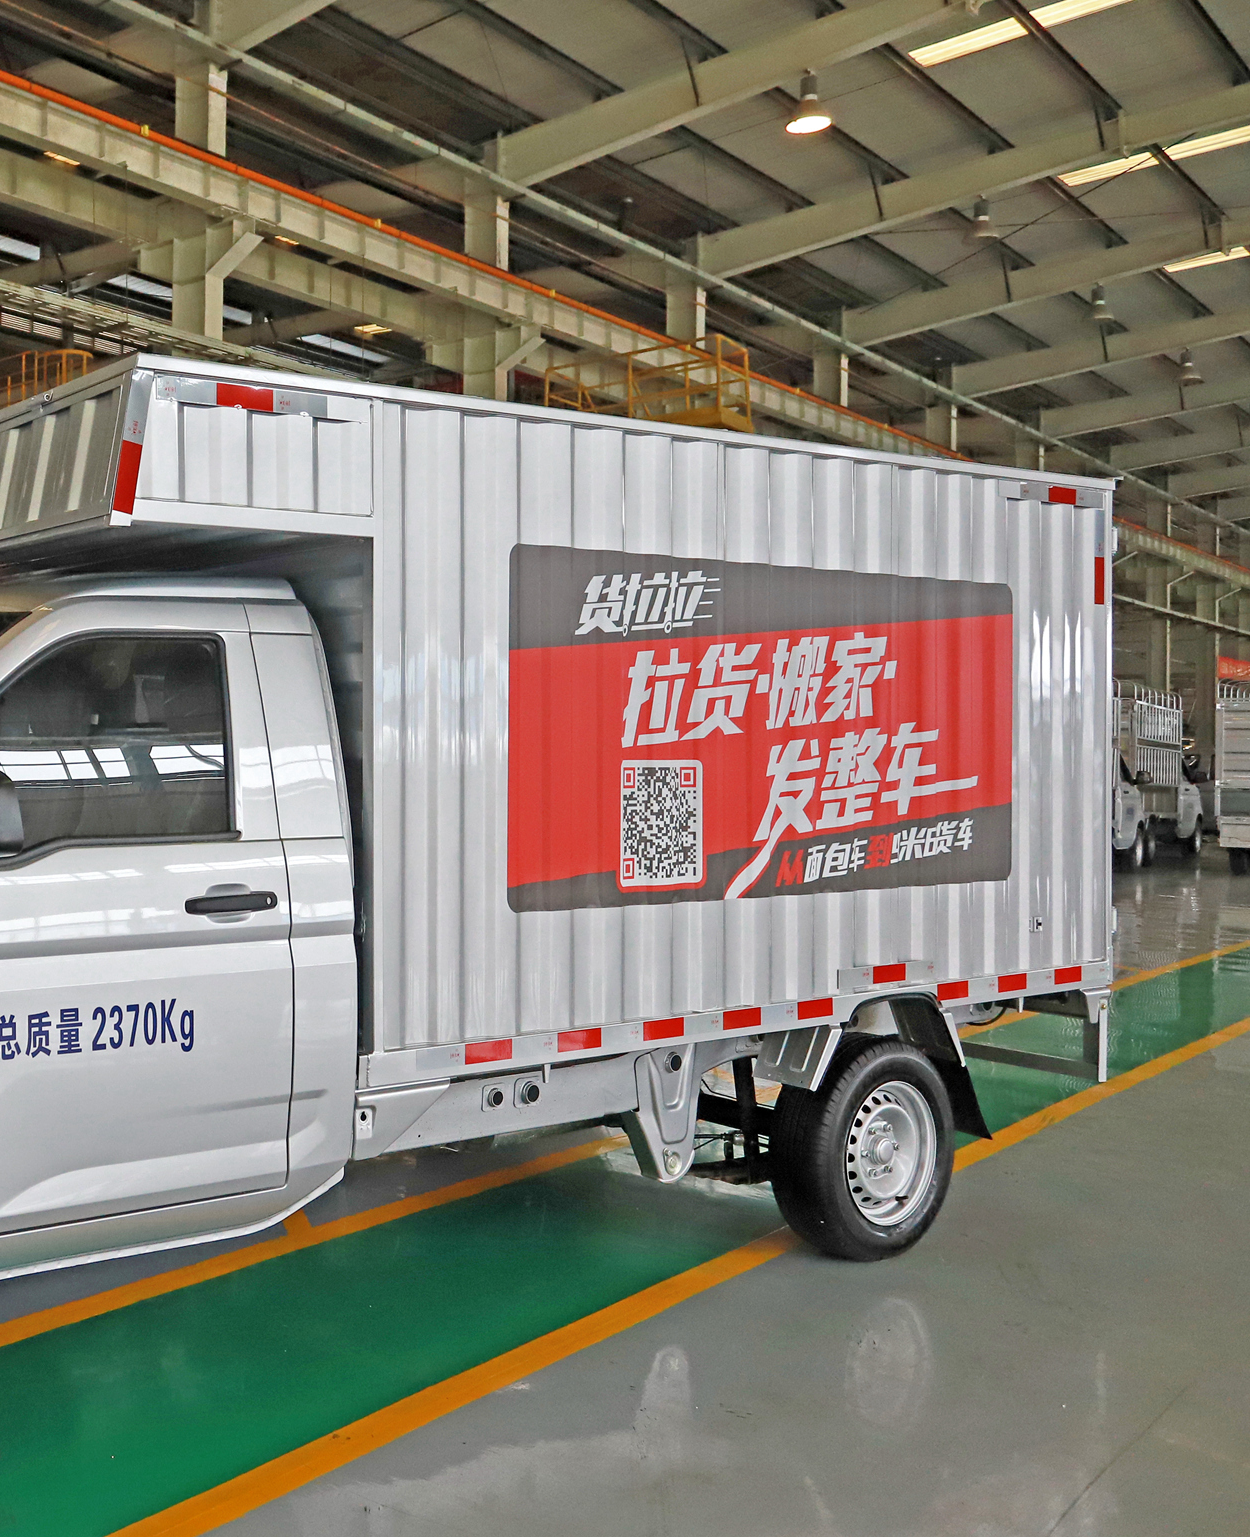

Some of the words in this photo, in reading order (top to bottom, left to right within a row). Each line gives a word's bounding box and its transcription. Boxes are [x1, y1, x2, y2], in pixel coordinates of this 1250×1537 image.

[574, 570, 715, 637] 货拉拉
[750, 721, 978, 852] 发整车
[91, 998, 196, 1053] 2370Kg
